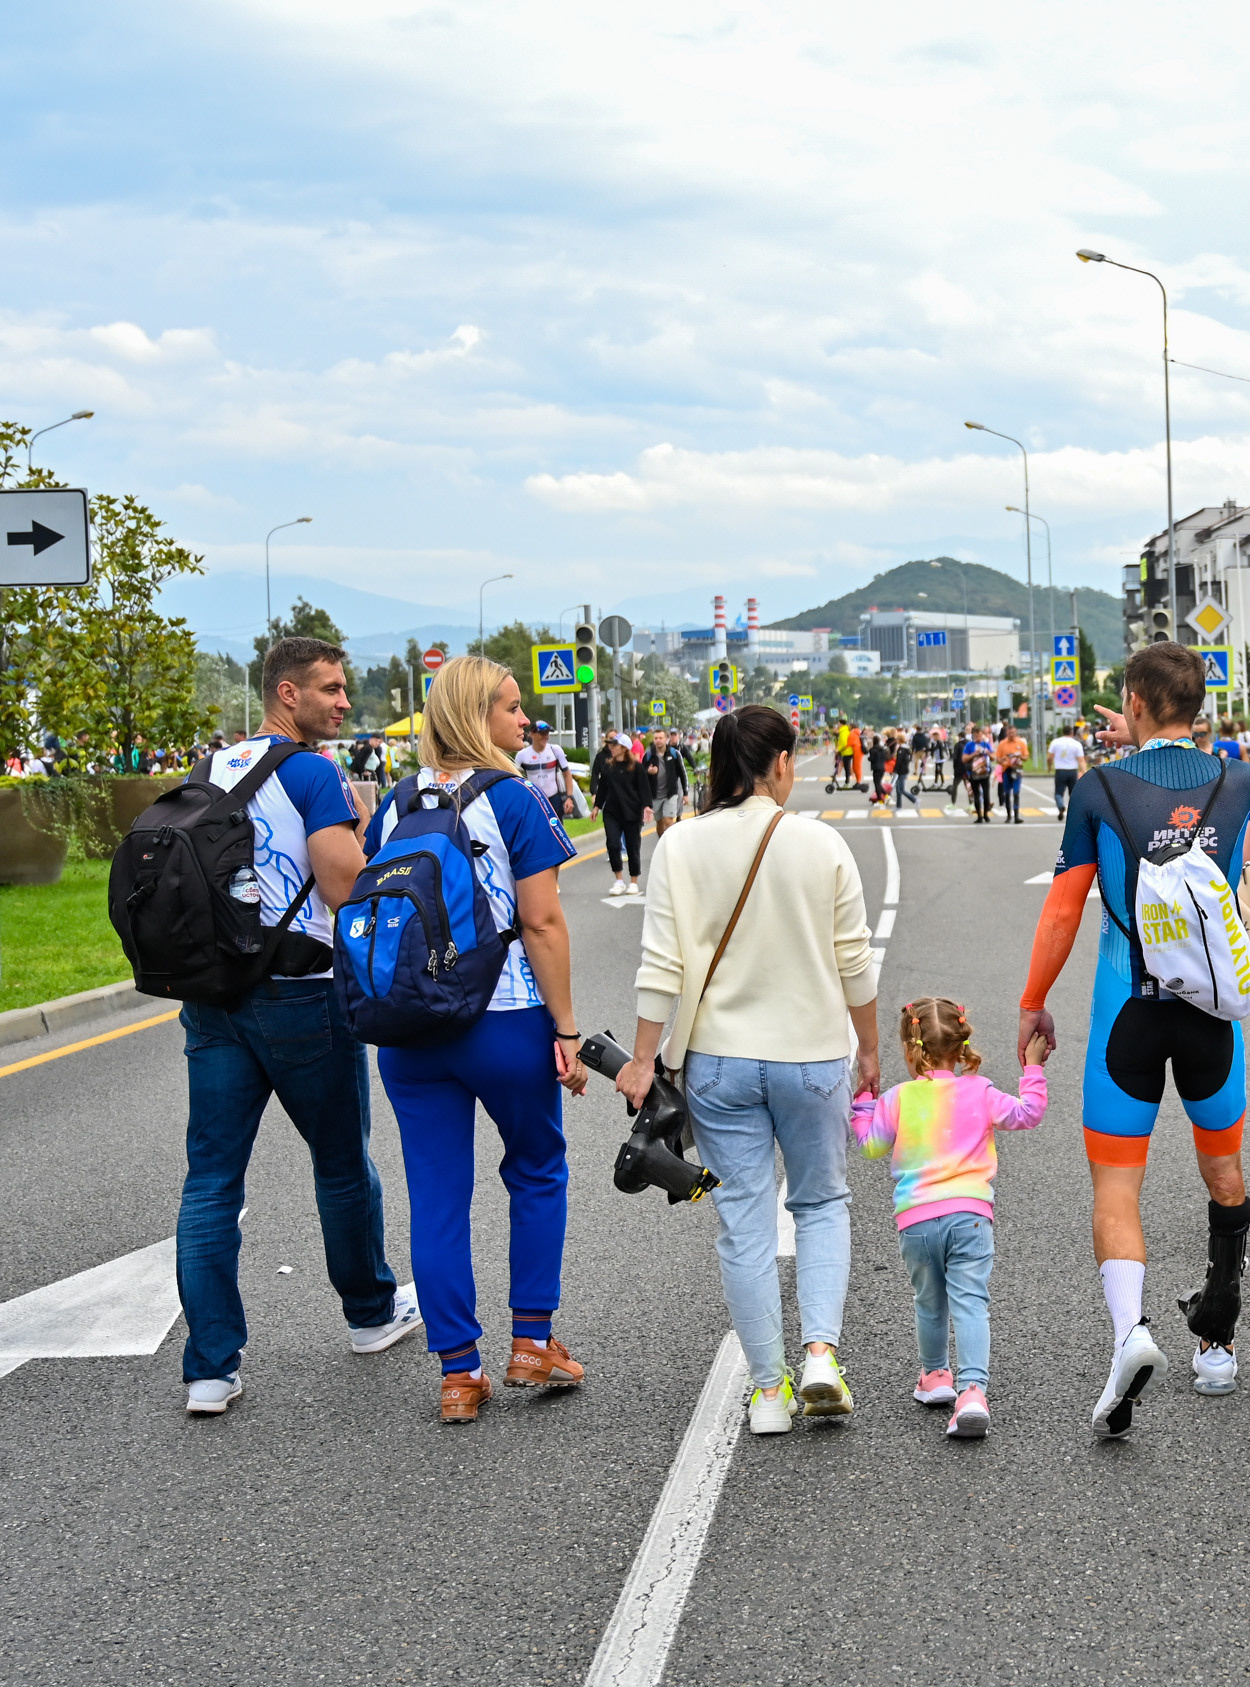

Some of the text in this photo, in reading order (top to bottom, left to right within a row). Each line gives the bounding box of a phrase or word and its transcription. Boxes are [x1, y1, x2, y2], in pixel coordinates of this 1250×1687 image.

[1142, 903, 1169, 920] IRON
[1143, 918, 1189, 945] STAR
[513, 1353, 542, 1367] ecco
[442, 1389, 460, 1399] cco
